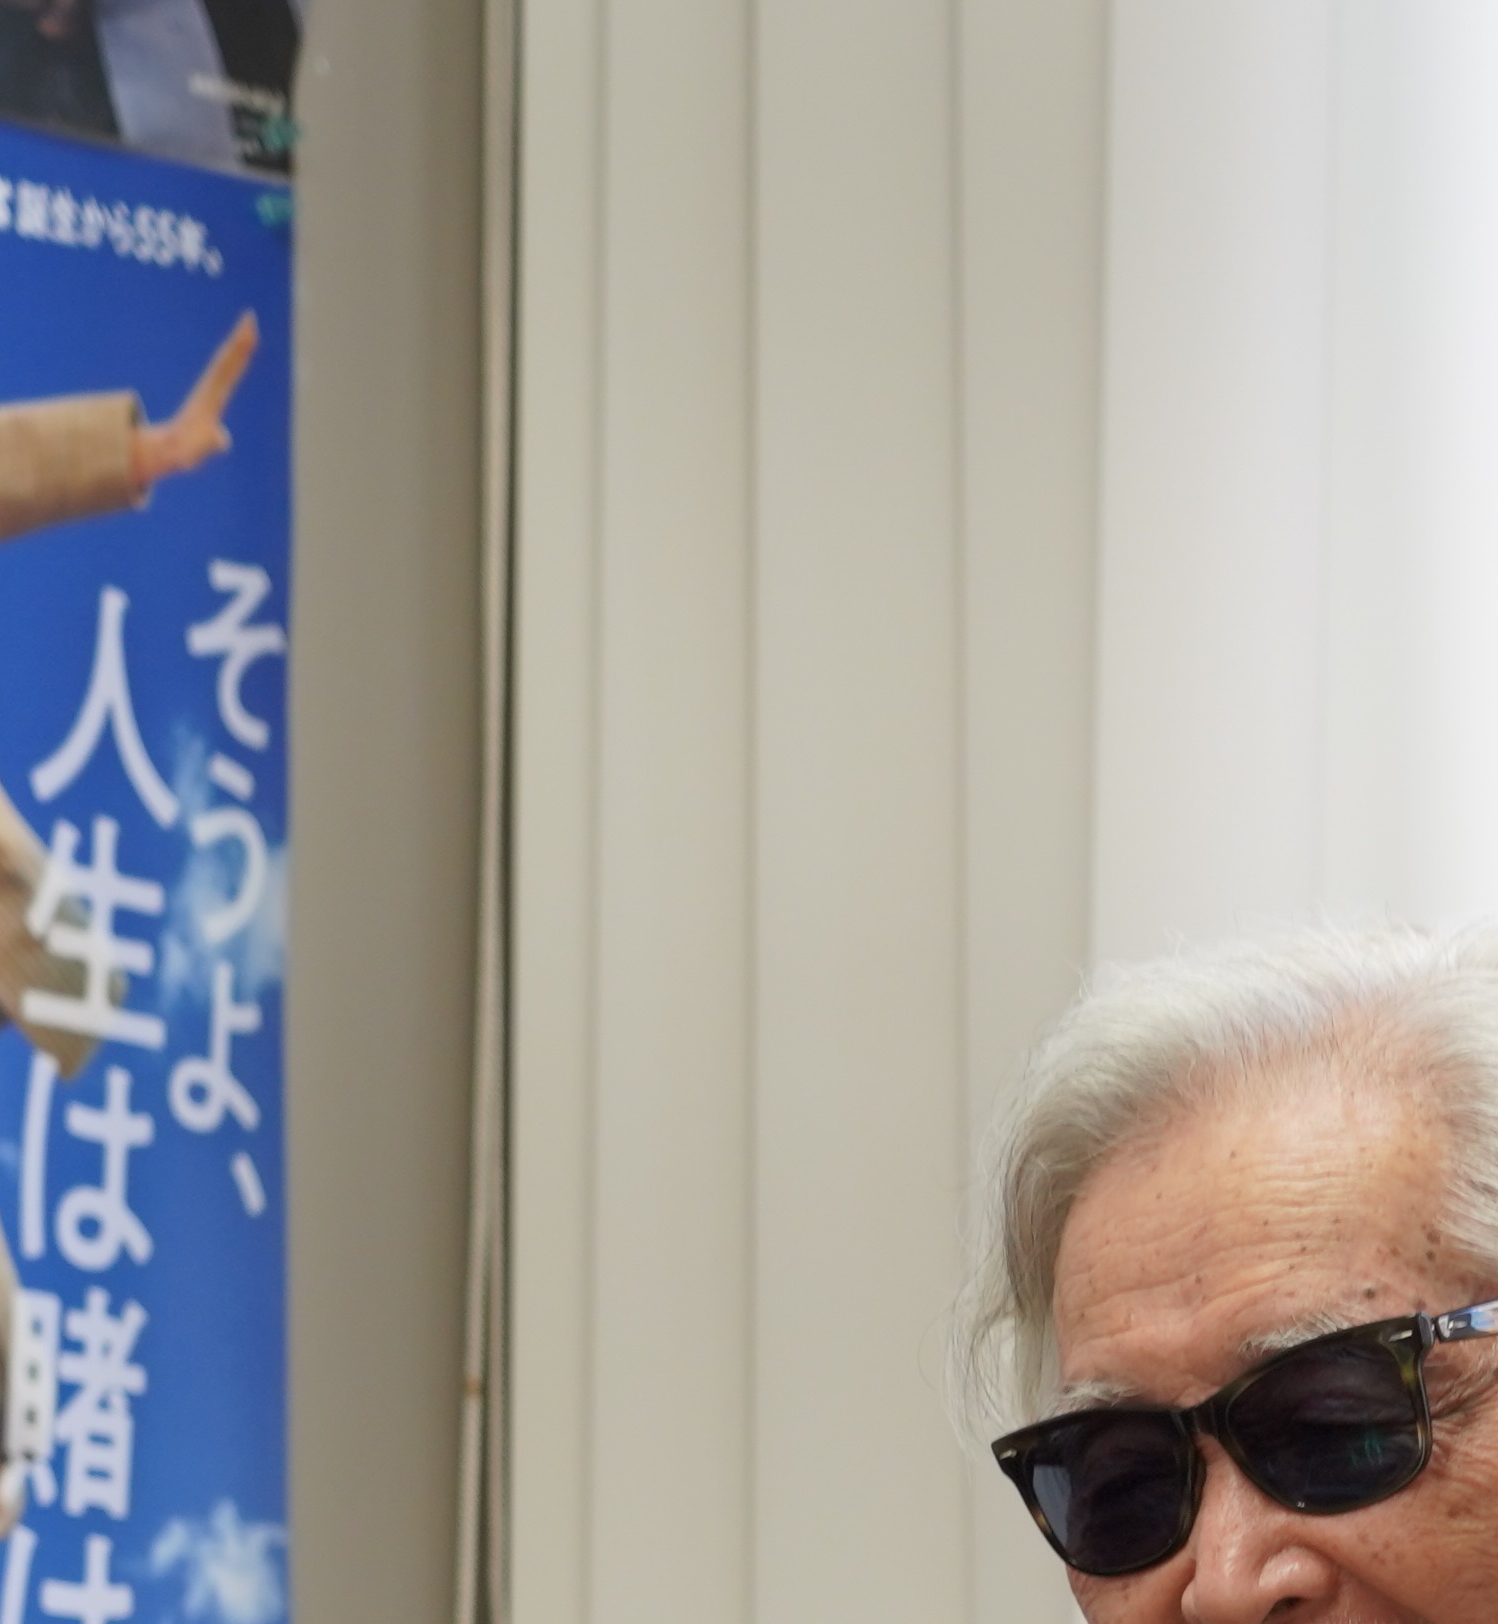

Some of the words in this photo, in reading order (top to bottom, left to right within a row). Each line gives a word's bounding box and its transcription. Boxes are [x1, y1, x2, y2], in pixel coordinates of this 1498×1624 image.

[15, 175, 225, 278] 誕生から55年。
[167, 557, 287, 1217] そうよ、
